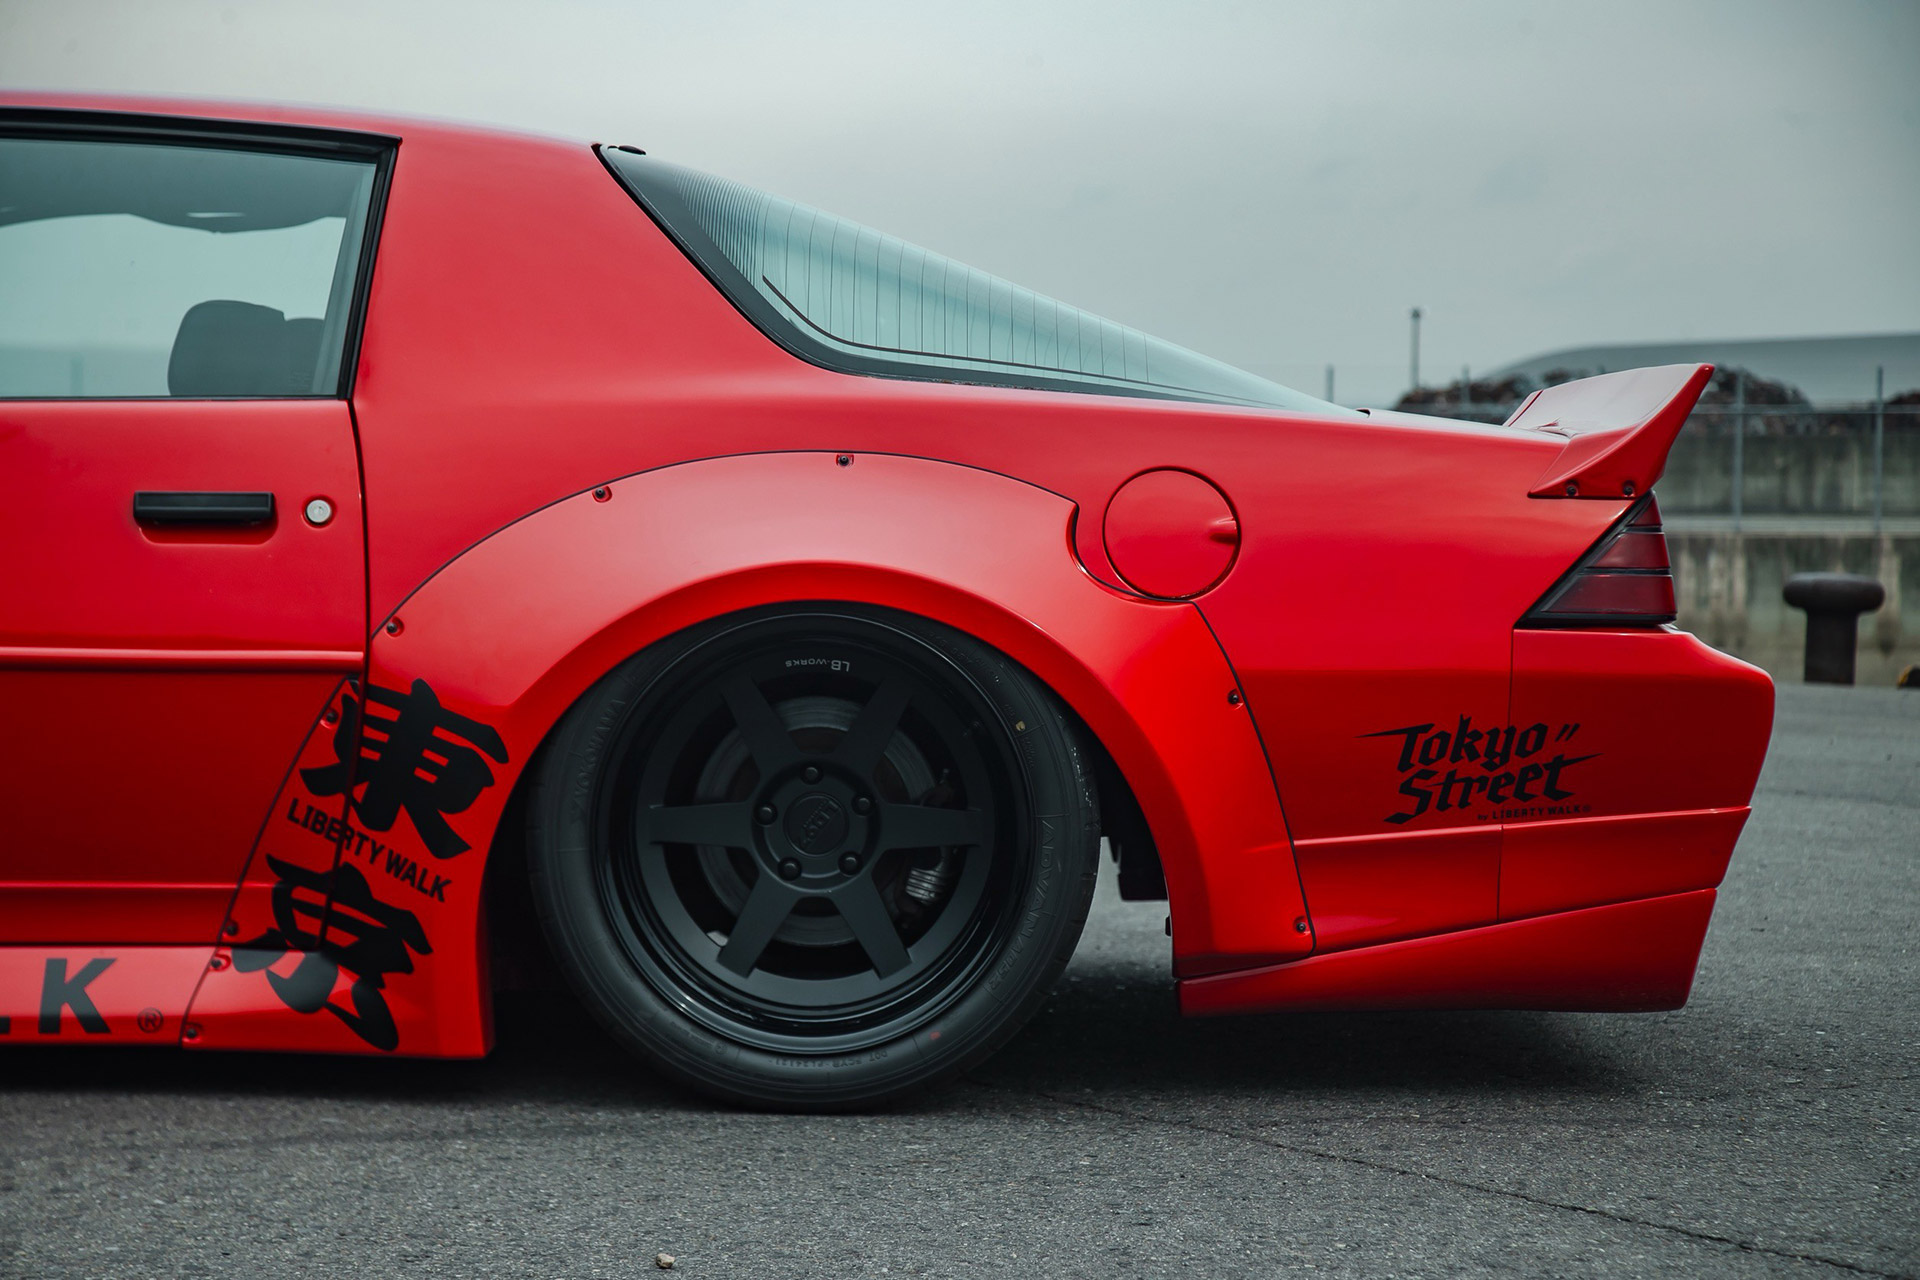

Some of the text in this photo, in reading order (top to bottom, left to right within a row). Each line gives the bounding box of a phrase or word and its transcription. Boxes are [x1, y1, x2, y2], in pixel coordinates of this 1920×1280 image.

[300, 678, 509, 859] 東
[1352, 713, 1549, 773] Tokyo
[1383, 753, 1605, 825] Street
[1492, 807, 1545, 819] LIBERTY
[286, 798, 452, 902] LIBERTY WALK
[230, 853, 434, 1051] 京
